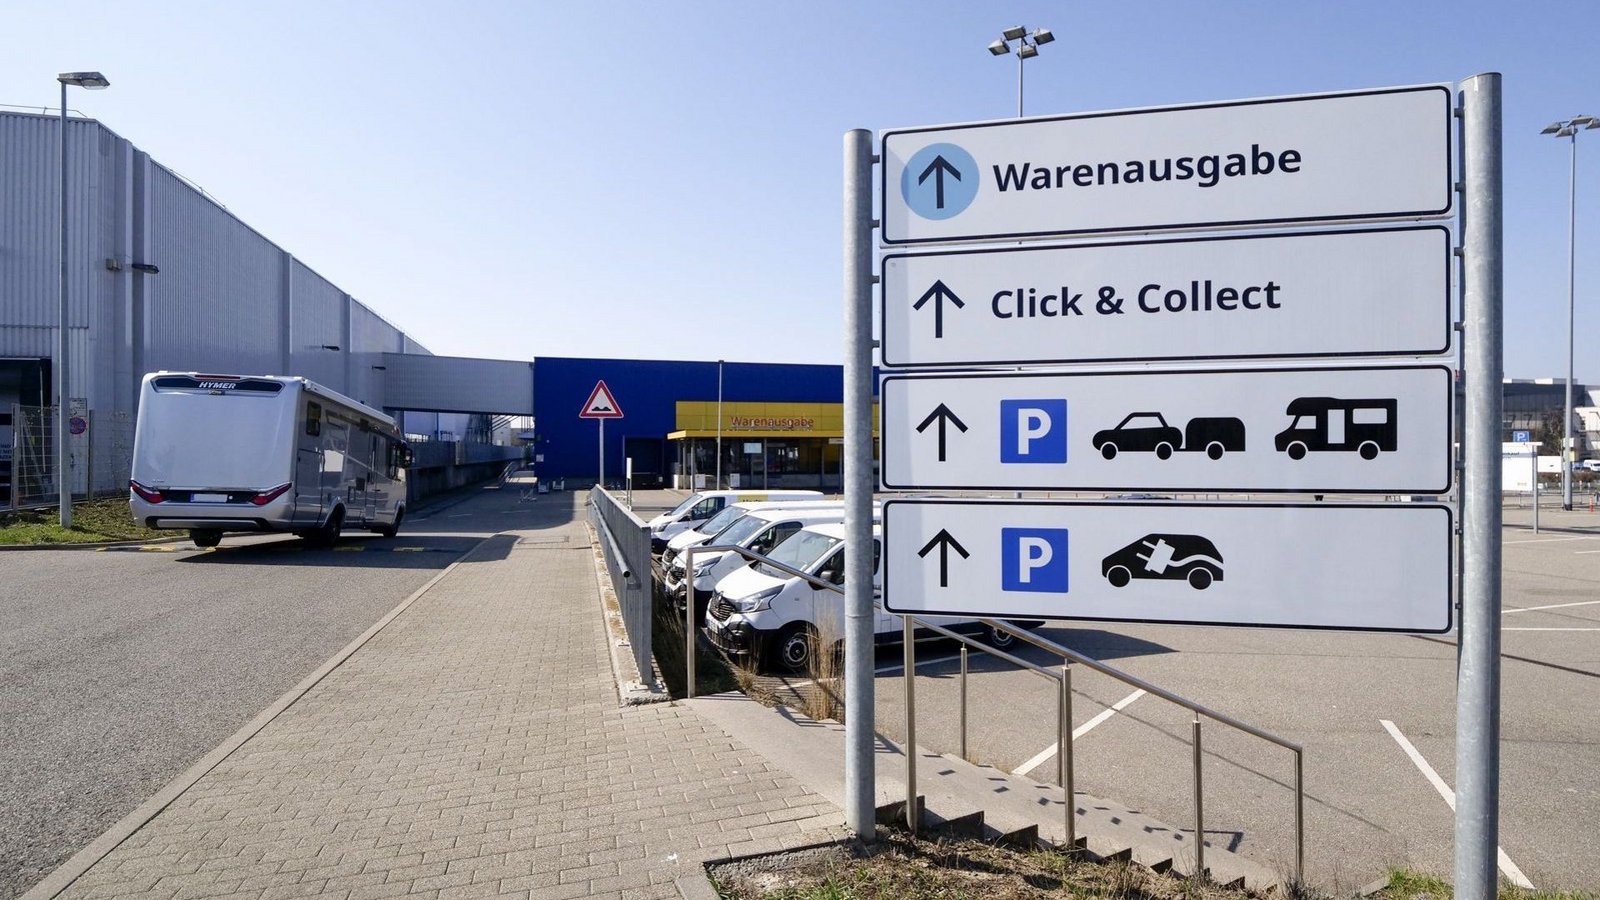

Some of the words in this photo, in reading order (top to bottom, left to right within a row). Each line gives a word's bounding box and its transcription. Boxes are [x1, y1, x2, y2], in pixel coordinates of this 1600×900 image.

[993, 144, 1302, 193] Warenausgabe
[992, 287, 1084, 319] Click
[1096, 286, 1125, 316] &
[1138, 279, 1281, 314] Collect
[198, 381, 237, 389] HYMER
[731, 416, 814, 428] Warenausgabe
[1018, 408, 1052, 455] P
[1517, 432, 1526, 442] P
[1019, 536, 1053, 583] P
